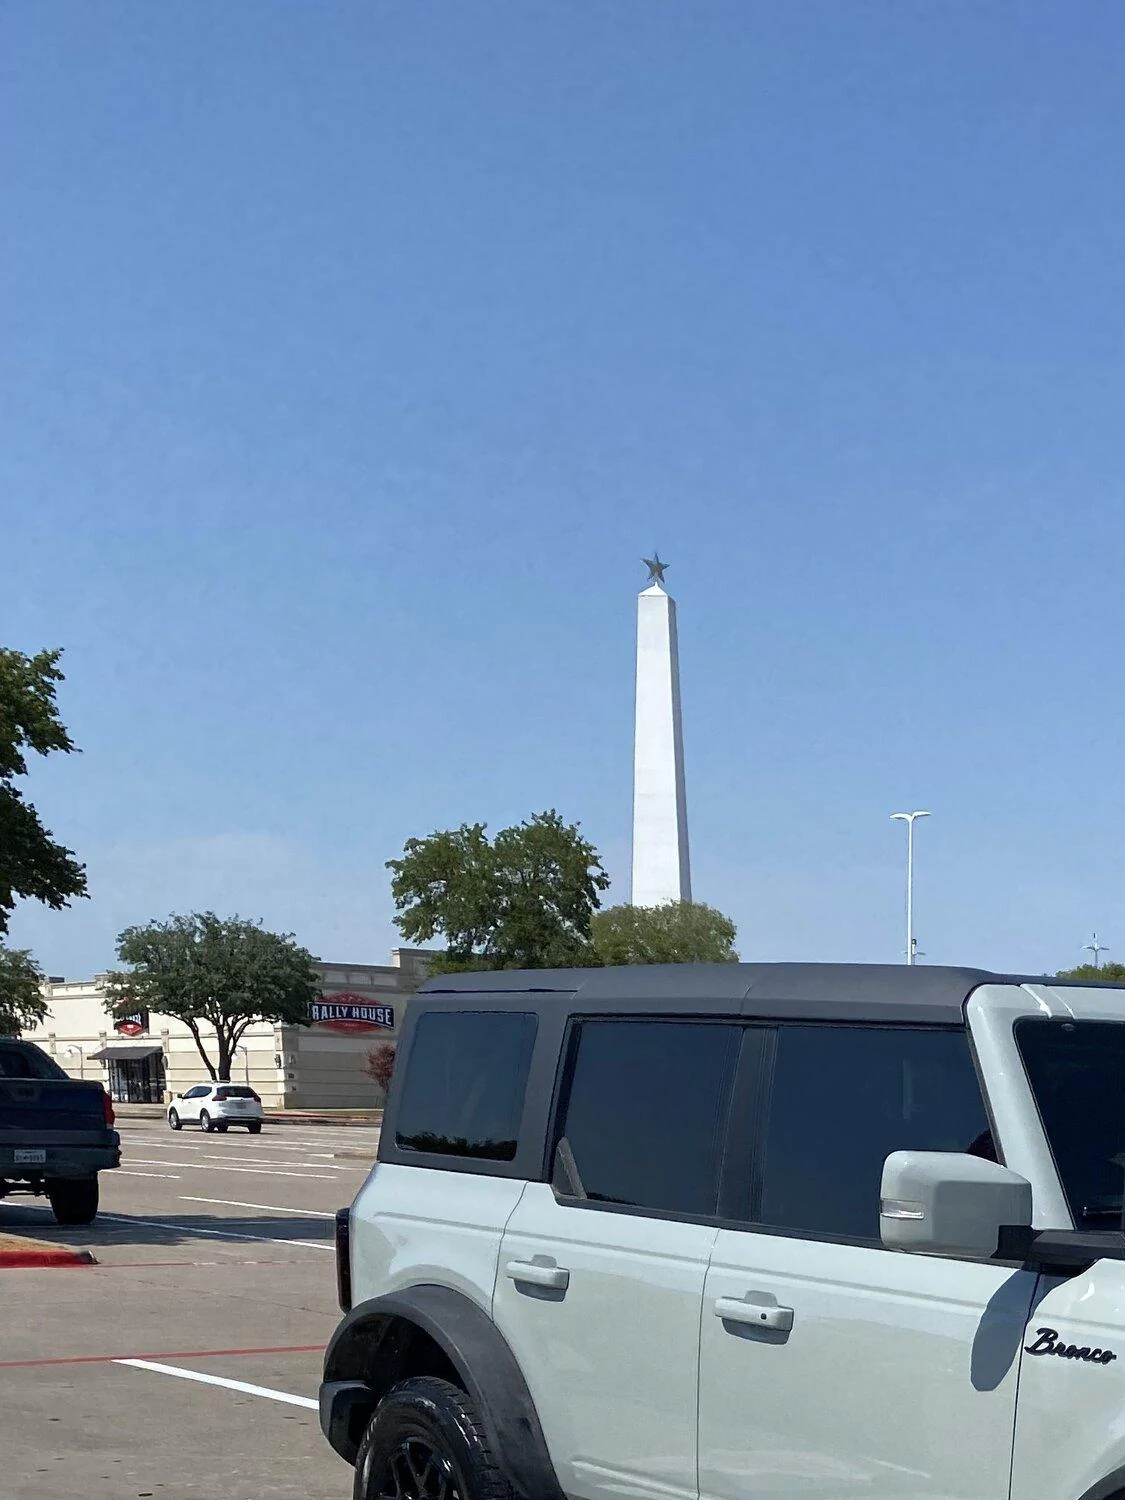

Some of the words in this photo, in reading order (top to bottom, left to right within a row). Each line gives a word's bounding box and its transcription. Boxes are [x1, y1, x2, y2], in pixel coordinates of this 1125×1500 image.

[312, 1005, 348, 1020] RALLY
[352, 1007, 392, 1025] HOUSE
[1023, 1327, 1117, 1366] Bronco
